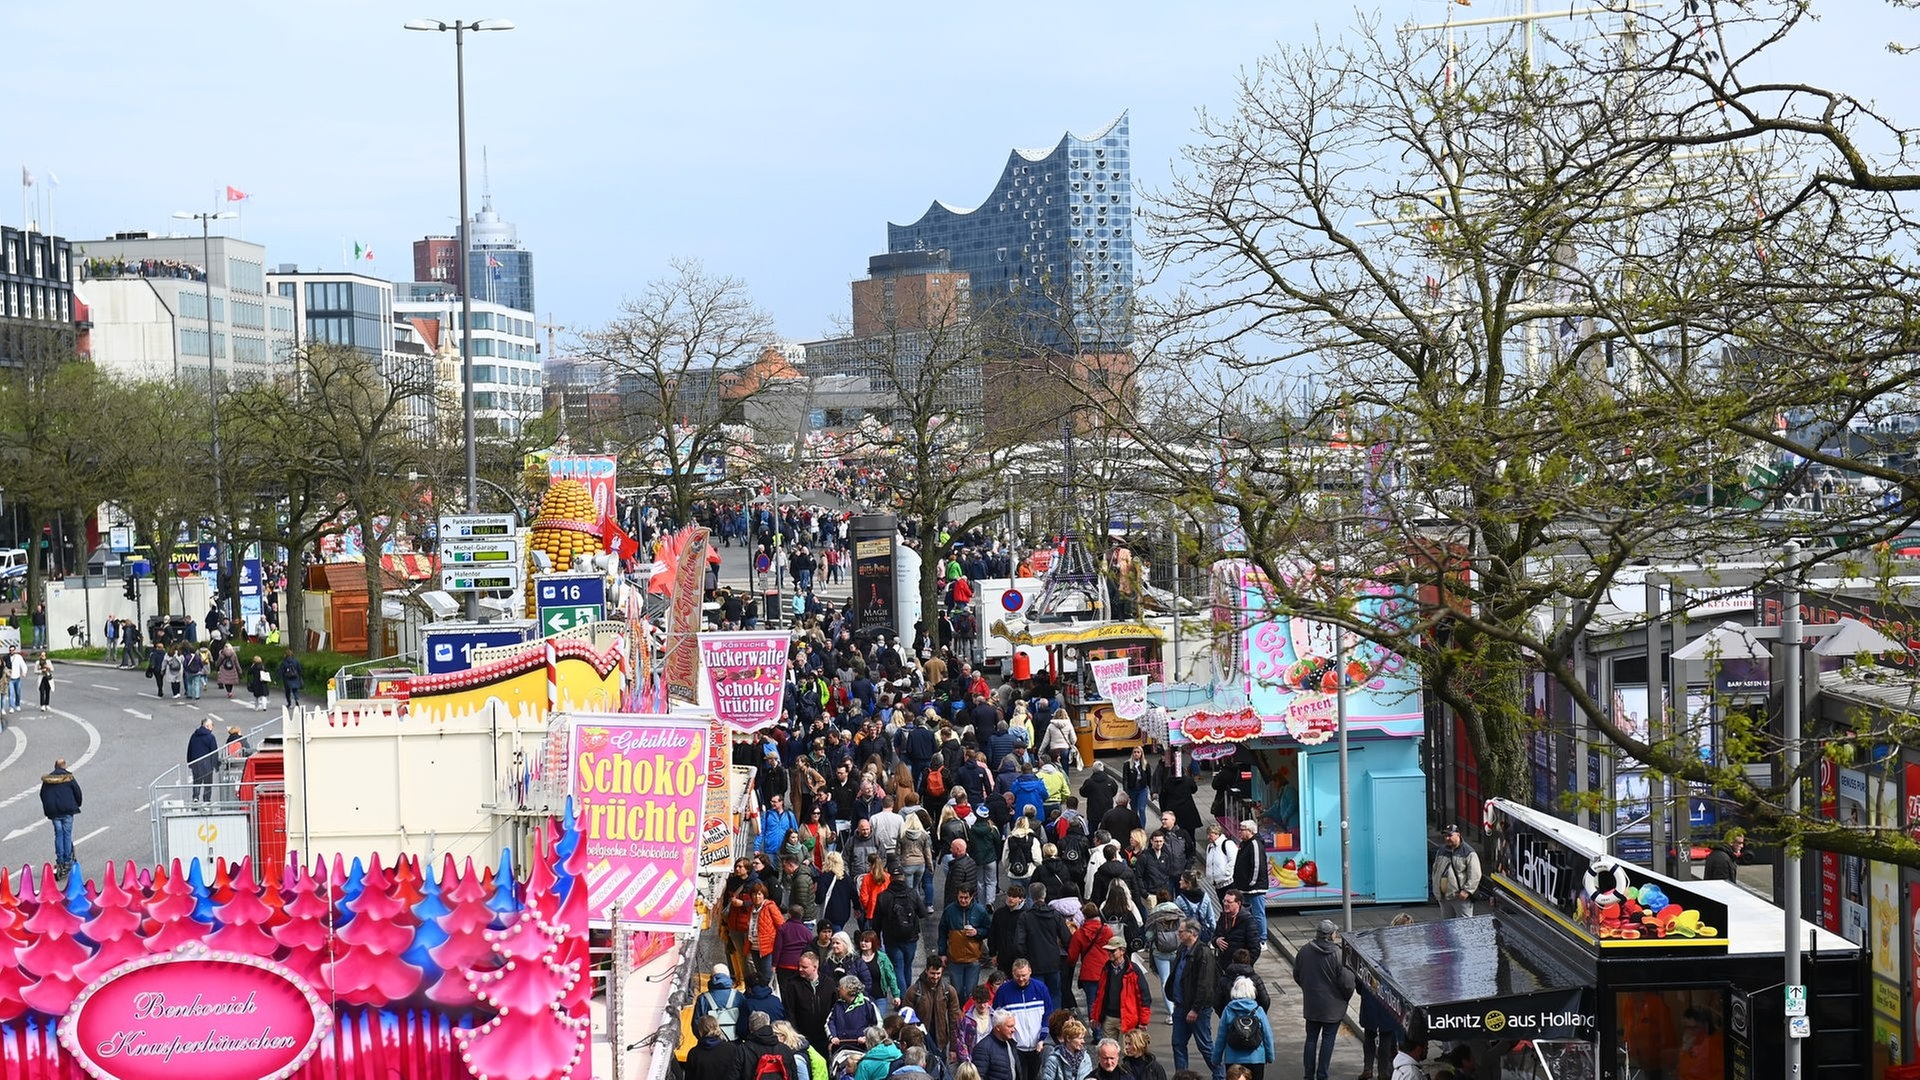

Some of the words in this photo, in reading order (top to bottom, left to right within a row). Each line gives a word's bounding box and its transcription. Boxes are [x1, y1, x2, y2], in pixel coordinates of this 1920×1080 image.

[560, 586, 581, 600] 16
[722, 641, 766, 649] KÖSTLICHE
[704, 648, 785, 668] Zuckerwatte
[716, 681, 780, 697] Schoko-
[1111, 678, 1144, 694] FROZEN
[720, 697, 775, 714] früchte
[1290, 699, 1332, 717] Frozen
[610, 727, 689, 756] Gekühlte
[578, 752, 707, 797] Schoko-
[1516, 832, 1559, 906] Lakritz
[133, 991, 258, 1021] Benkovich
[1427, 1013, 1481, 1029] Lakritz
[1507, 1014, 1537, 1028] aus
[96, 1026, 296, 1064] Knusperhäuschen
